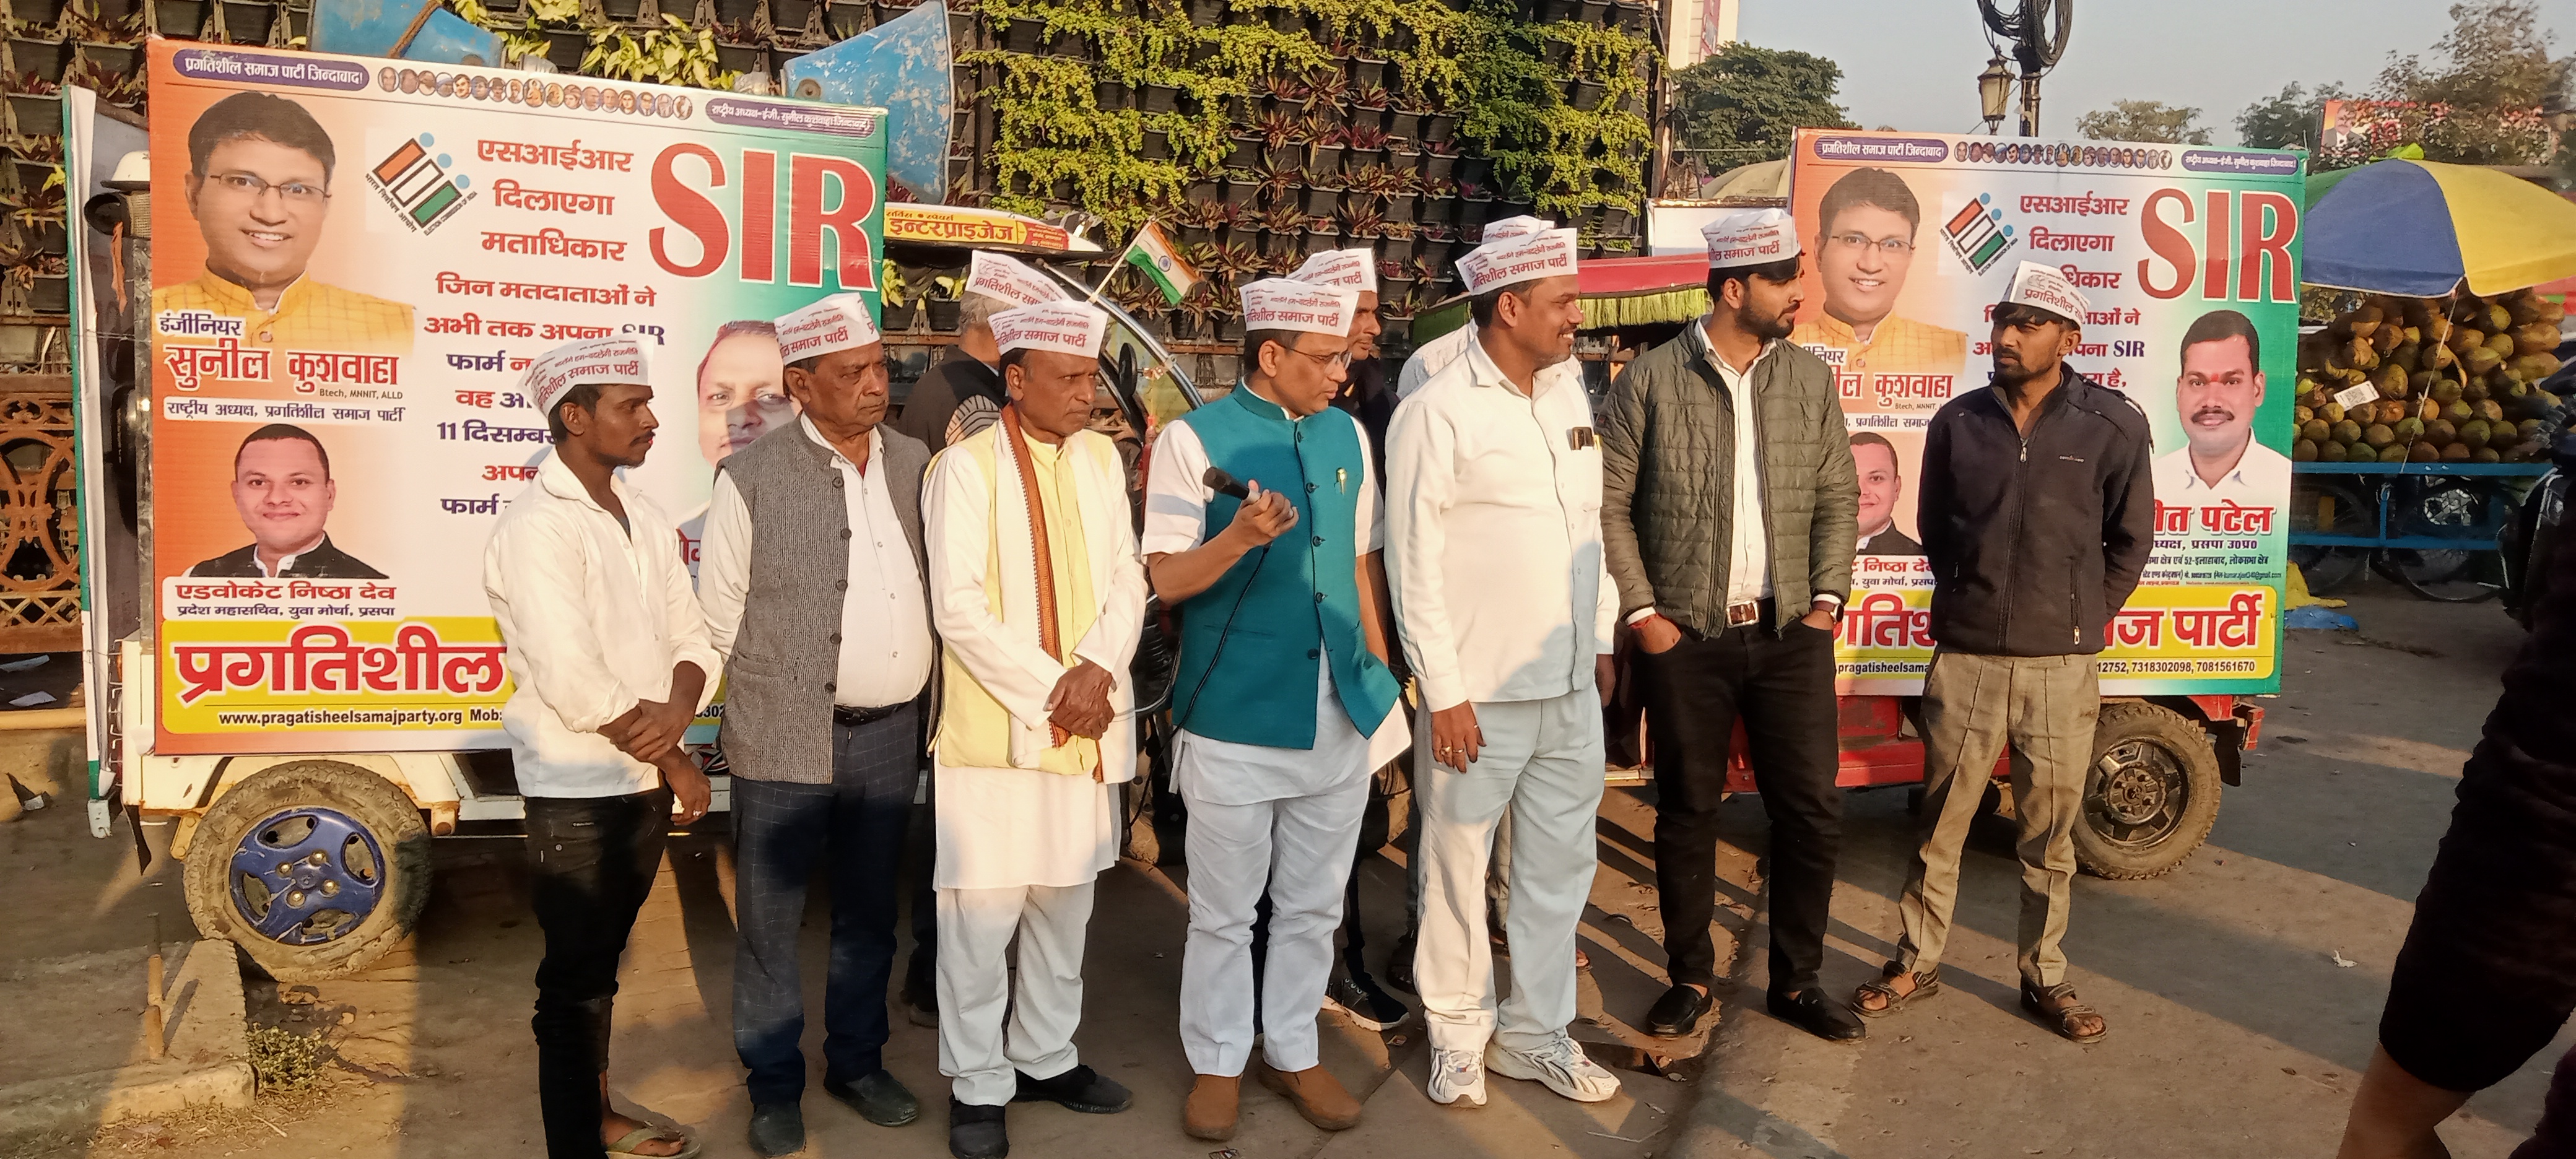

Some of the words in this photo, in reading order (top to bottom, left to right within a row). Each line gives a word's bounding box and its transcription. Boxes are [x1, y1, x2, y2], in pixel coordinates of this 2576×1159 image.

[185, 56, 242, 75] प्रगतिशील
[245, 62, 279, 77] समाज
[281, 63, 305, 80] पार्टी
[477, 139, 634, 173] एसआईआर
[1822, 140, 1861, 155] प्रगतिशील
[1861, 144, 1886, 155] समाज
[1887, 143, 1904, 155] पार्टी
[493, 178, 615, 216] दिलाएगा
[2020, 191, 2130, 216] एसआईआर
[648, 142, 879, 292] SIR
[481, 227, 627, 261] मताधिकार
[2029, 225, 2115, 252] दिलाएगा
[2138, 188, 2297, 303] SIR
[1723, 247, 1755, 260] समाज
[1757, 240, 1780, 254] पार्टी
[1509, 259, 1546, 275] समाज
[1547, 253, 1568, 268] पार्टी
[1342, 271, 1363, 285] पार्टी
[2060, 264, 2121, 289] धिकार
[436, 271, 495, 297] जिन
[499, 281, 630, 306] मतदाताओं
[633, 285, 657, 307] ने
[973, 277, 1022, 299] प्रगतिशील
[2024, 289, 2074, 313] प्रगतिशील
[160, 312, 243, 336] इंजीनियर
[424, 311, 482, 335] अभी
[486, 320, 536, 338] तक
[539, 323, 614, 341] अपना
[1277, 311, 1315, 324] समाज
[1317, 313, 1340, 328] पार्टी
[2124, 308, 2141, 326] ने
[791, 335, 822, 353] समाज
[824, 326, 849, 344] पार्टी
[1024, 330, 1060, 343] समाज
[1062, 333, 1087, 348] पार्टी
[2067, 344, 2108, 357] पना
[2113, 340, 2145, 357] SIR
[165, 339, 271, 388] सुनील
[287, 351, 399, 392] कुशवाहा
[446, 350, 506, 372] फार्म
[568, 365, 610, 379] समाज
[613, 361, 639, 376] पार्टी
[2107, 367, 2127, 388] है,
[320, 388, 347, 398] Btech,
[349, 389, 379, 400] MNNIT,
[381, 391, 404, 400] ALLD
[455, 390, 495, 409] वह
[1875, 374, 1954, 407] कुशवाहा
[167, 399, 208, 419] राष्ट्रीय
[215, 406, 258, 417] अध्यक्ष,
[264, 403, 325, 419] प्रगतिशील
[332, 407, 371, 421] समाज
[377, 407, 406, 422] पार्टी
[1856, 415, 1898, 428] प्रगतिशील
[1903, 418, 1930, 428] समाज
[437, 422, 456, 440] 11
[440, 493, 500, 515] फार्म
[2200, 498, 2274, 532] पटेल
[2191, 540, 2222, 549] प्रसपा
[1863, 557, 1908, 572] निष्ठा
[175, 581, 283, 599] एडवोकेट
[288, 580, 353, 599] निष्ठा
[359, 581, 397, 600] देव
[1862, 578, 1880, 588] युवा
[1882, 576, 1908, 586] मोर्चा,
[177, 603, 211, 617] प्रदेश
[214, 603, 284, 617] महासचिव,
[288, 606, 314, 619] युवा
[318, 604, 354, 617] मोर्चा,
[359, 607, 396, 617] प्रसपा
[2173, 593, 2263, 648] पार्टी
[175, 625, 507, 704] प्रगतिशील
[2097, 662, 2129, 675] 12752,
[2131, 661, 2194, 674] 7318302098,
[2196, 661, 2255, 672] 7081561670
[219, 709, 462, 727] www.pragatisheelsamajparty.org
